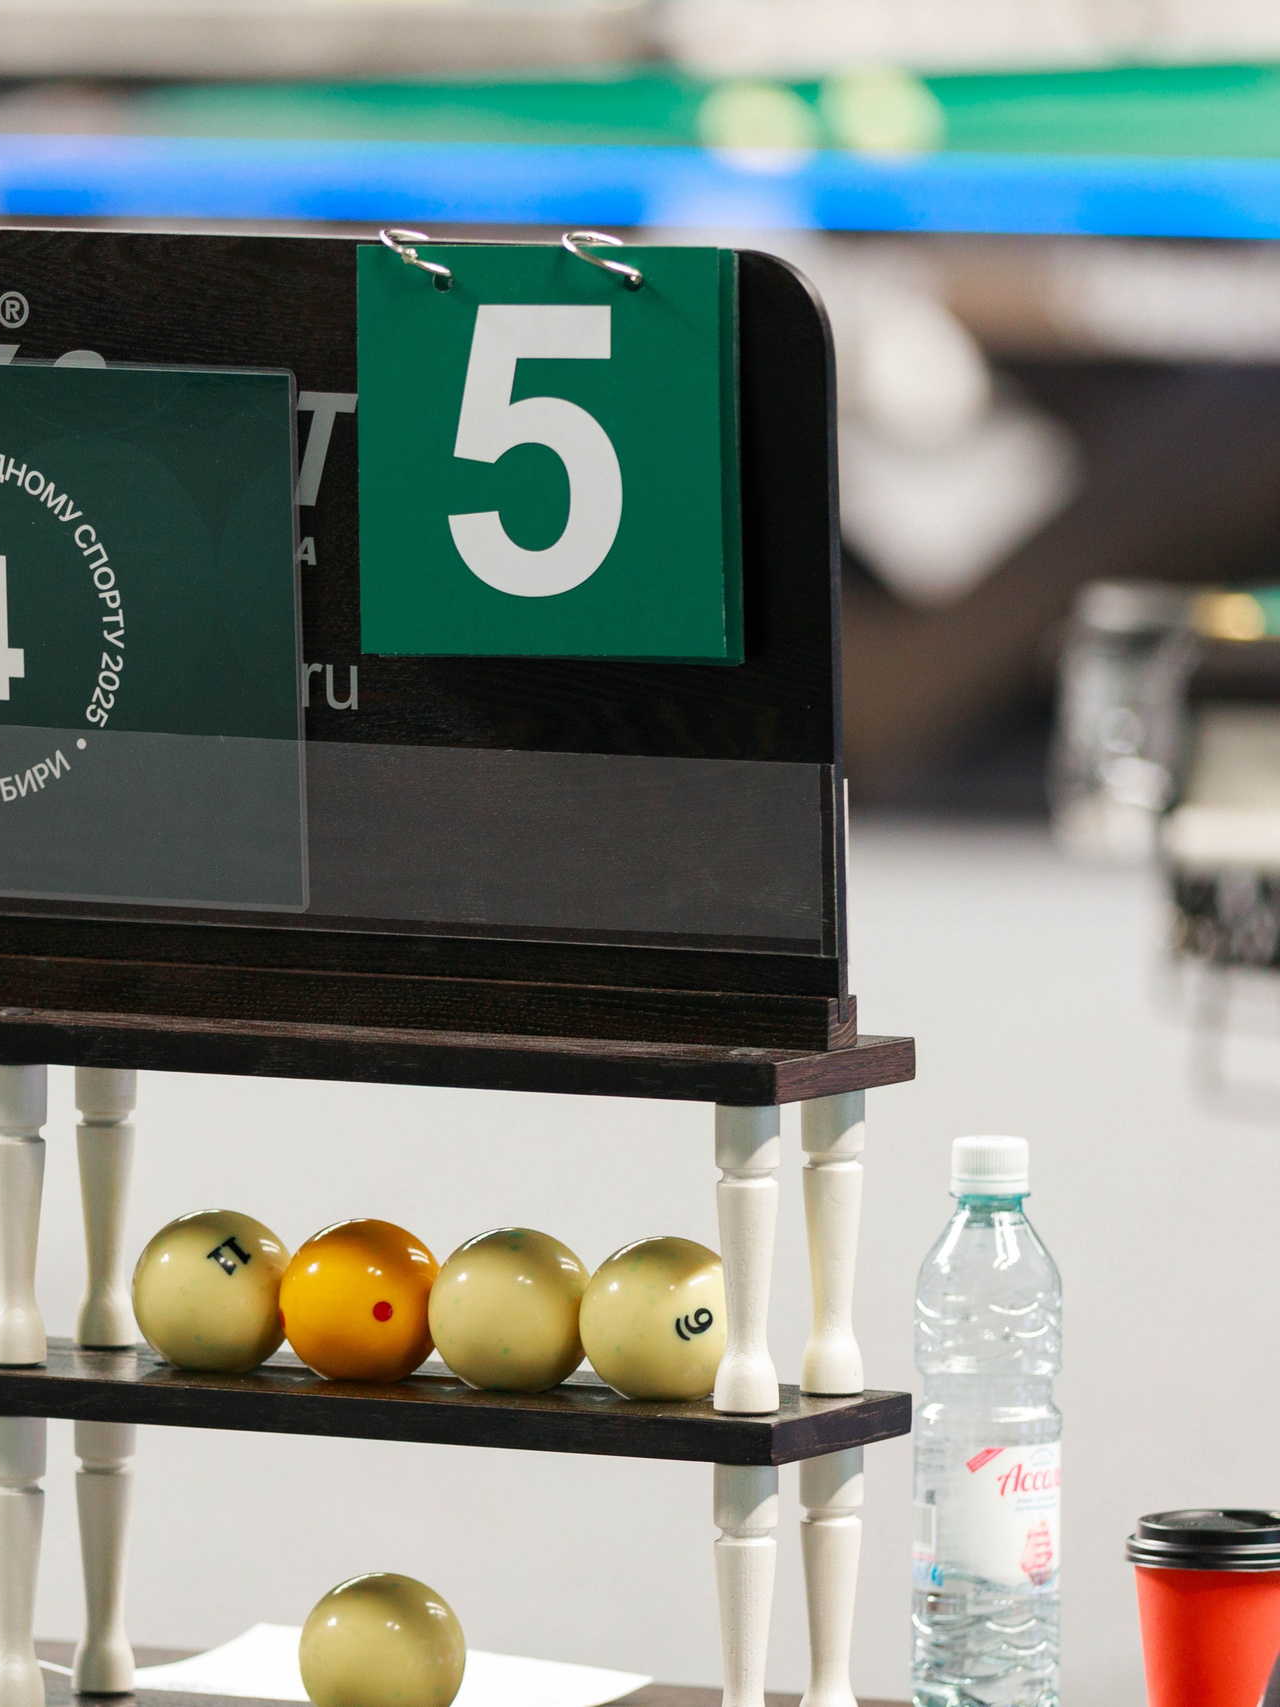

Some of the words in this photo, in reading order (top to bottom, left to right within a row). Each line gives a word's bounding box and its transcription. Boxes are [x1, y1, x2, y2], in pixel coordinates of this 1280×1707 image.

[448, 304, 623, 598] 5
[73, 523, 125, 649] СПОРТУ
[85, 651, 124, 728] 2025
[206, 1236, 252, 1276] 11
